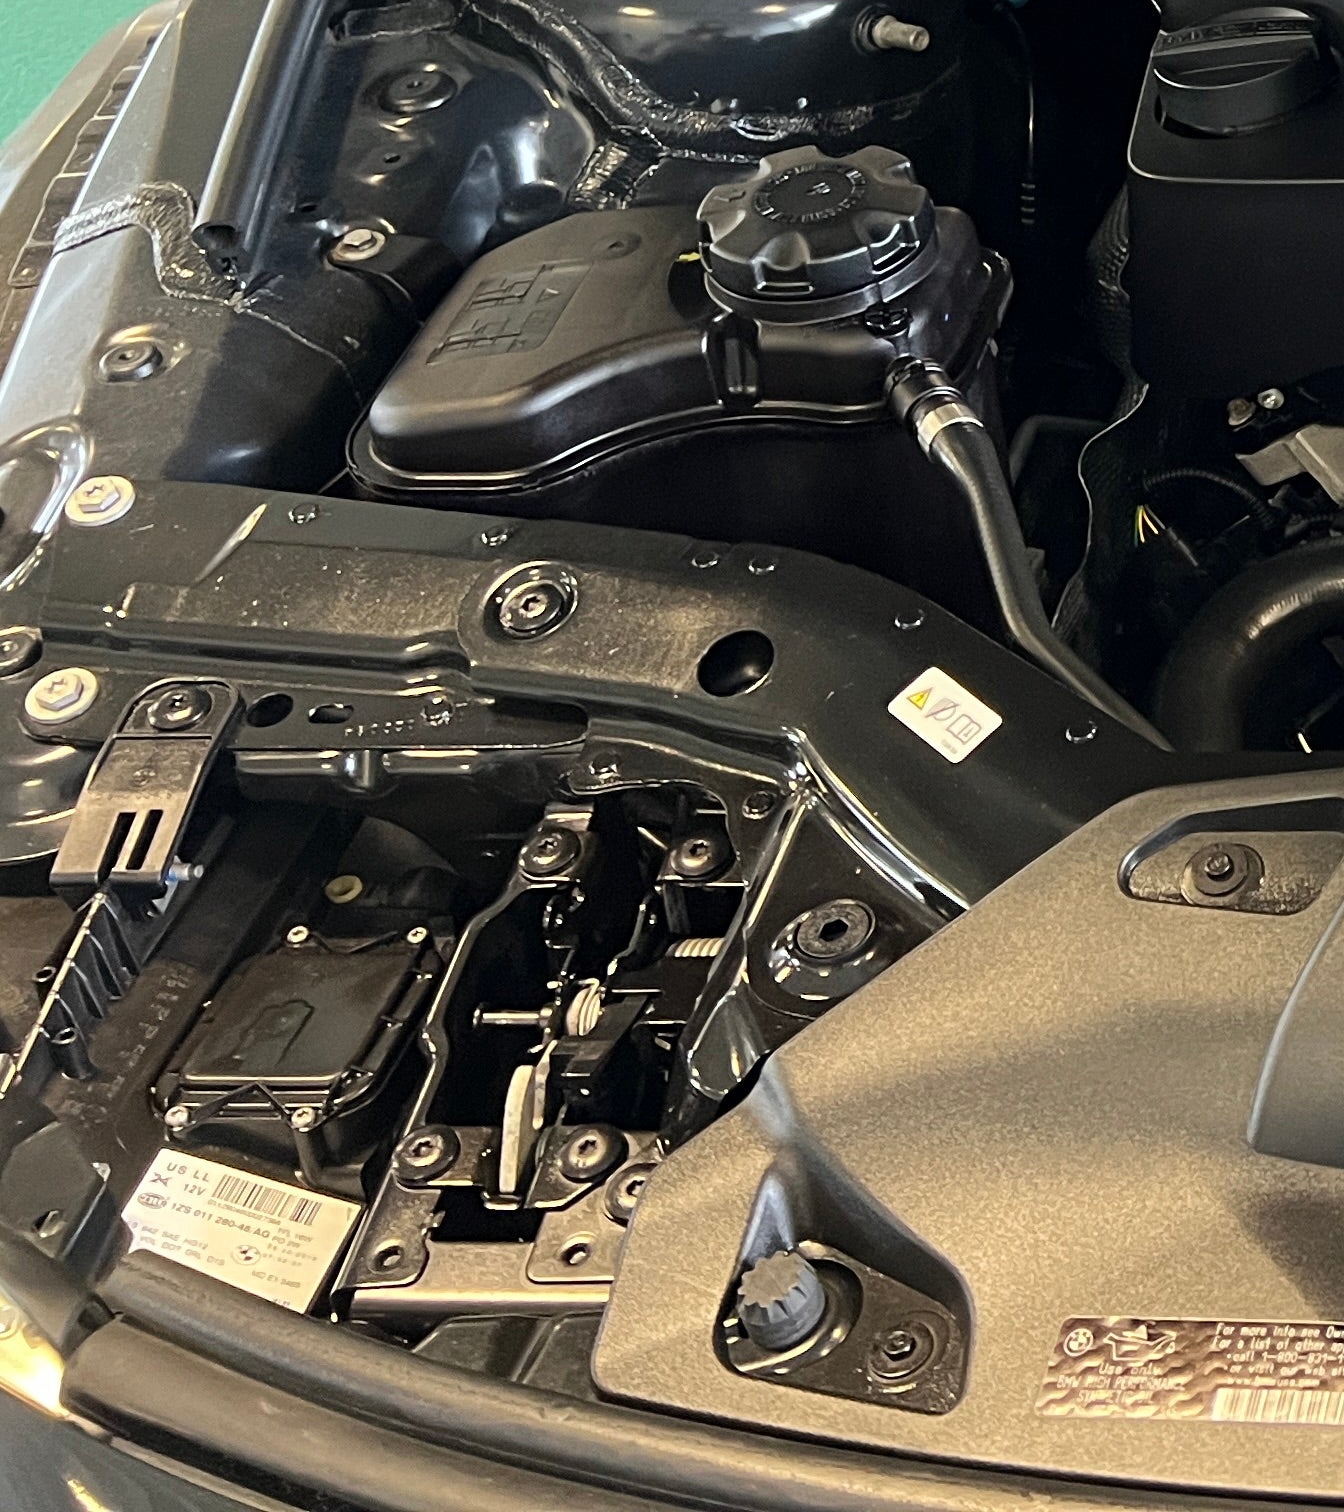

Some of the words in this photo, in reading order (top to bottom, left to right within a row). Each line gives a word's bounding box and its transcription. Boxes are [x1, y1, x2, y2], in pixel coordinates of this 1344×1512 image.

[167, 1162, 188, 1175] US
[193, 1170, 209, 1182] LL
[183, 1183, 206, 1196] 12V
[193, 1209, 213, 1221] 011
[1240, 1326, 1267, 1337] more
